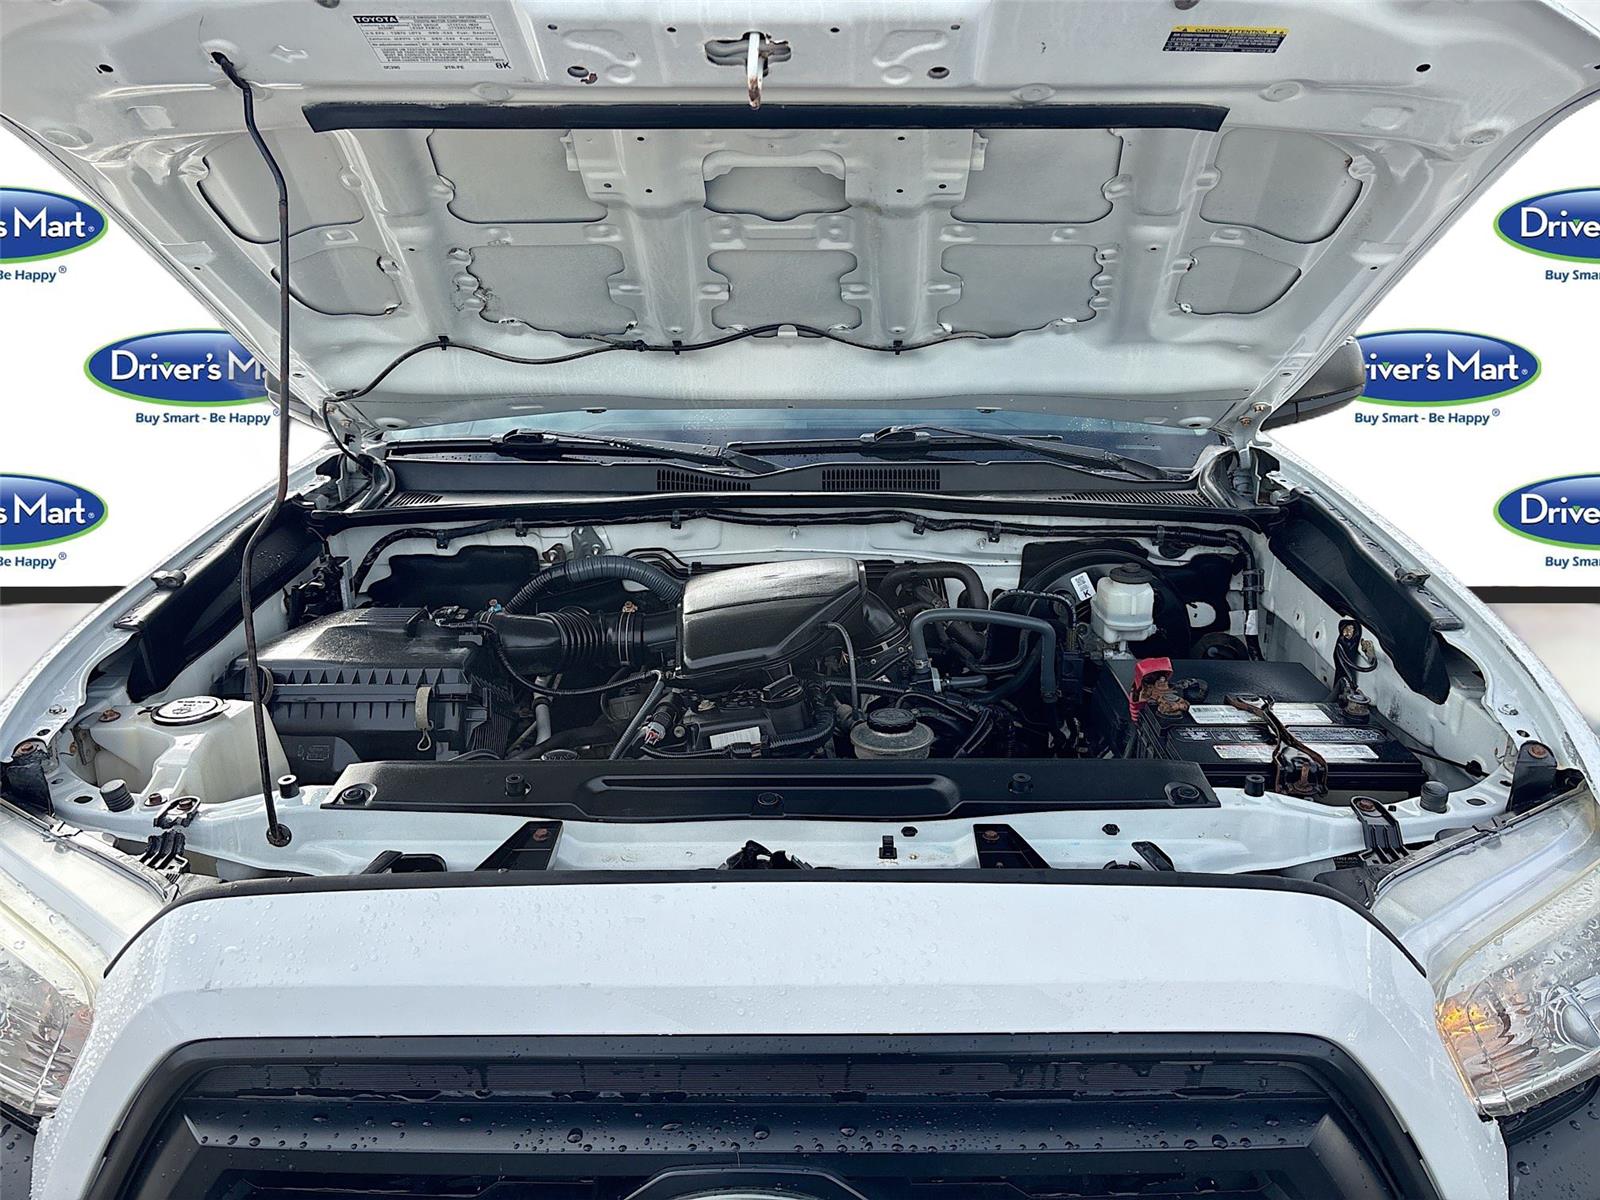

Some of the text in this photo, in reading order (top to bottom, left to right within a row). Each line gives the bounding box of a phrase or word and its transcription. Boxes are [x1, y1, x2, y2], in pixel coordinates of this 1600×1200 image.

[14, 206, 86, 237] Mart
[15, 269, 57, 283] Happy
[1545, 269, 1600, 283] Buy Sma
[111, 350, 222, 381] Driver's
[1447, 349, 1519, 381] Mart
[136, 412, 159, 425] Buy
[163, 412, 199, 423] Smart
[209, 412, 226, 423] Be
[229, 412, 271, 426] Happy
[1354, 412, 1378, 425] Buy
[1382, 412, 1418, 423] Smart
[1428, 412, 1445, 423] Be
[1448, 412, 1490, 426] Happy
[14, 492, 86, 524] Mart
[15, 556, 57, 570] Happy
[1545, 556, 1600, 570] Buy Sma
[1082, 589, 1091, 598] K
